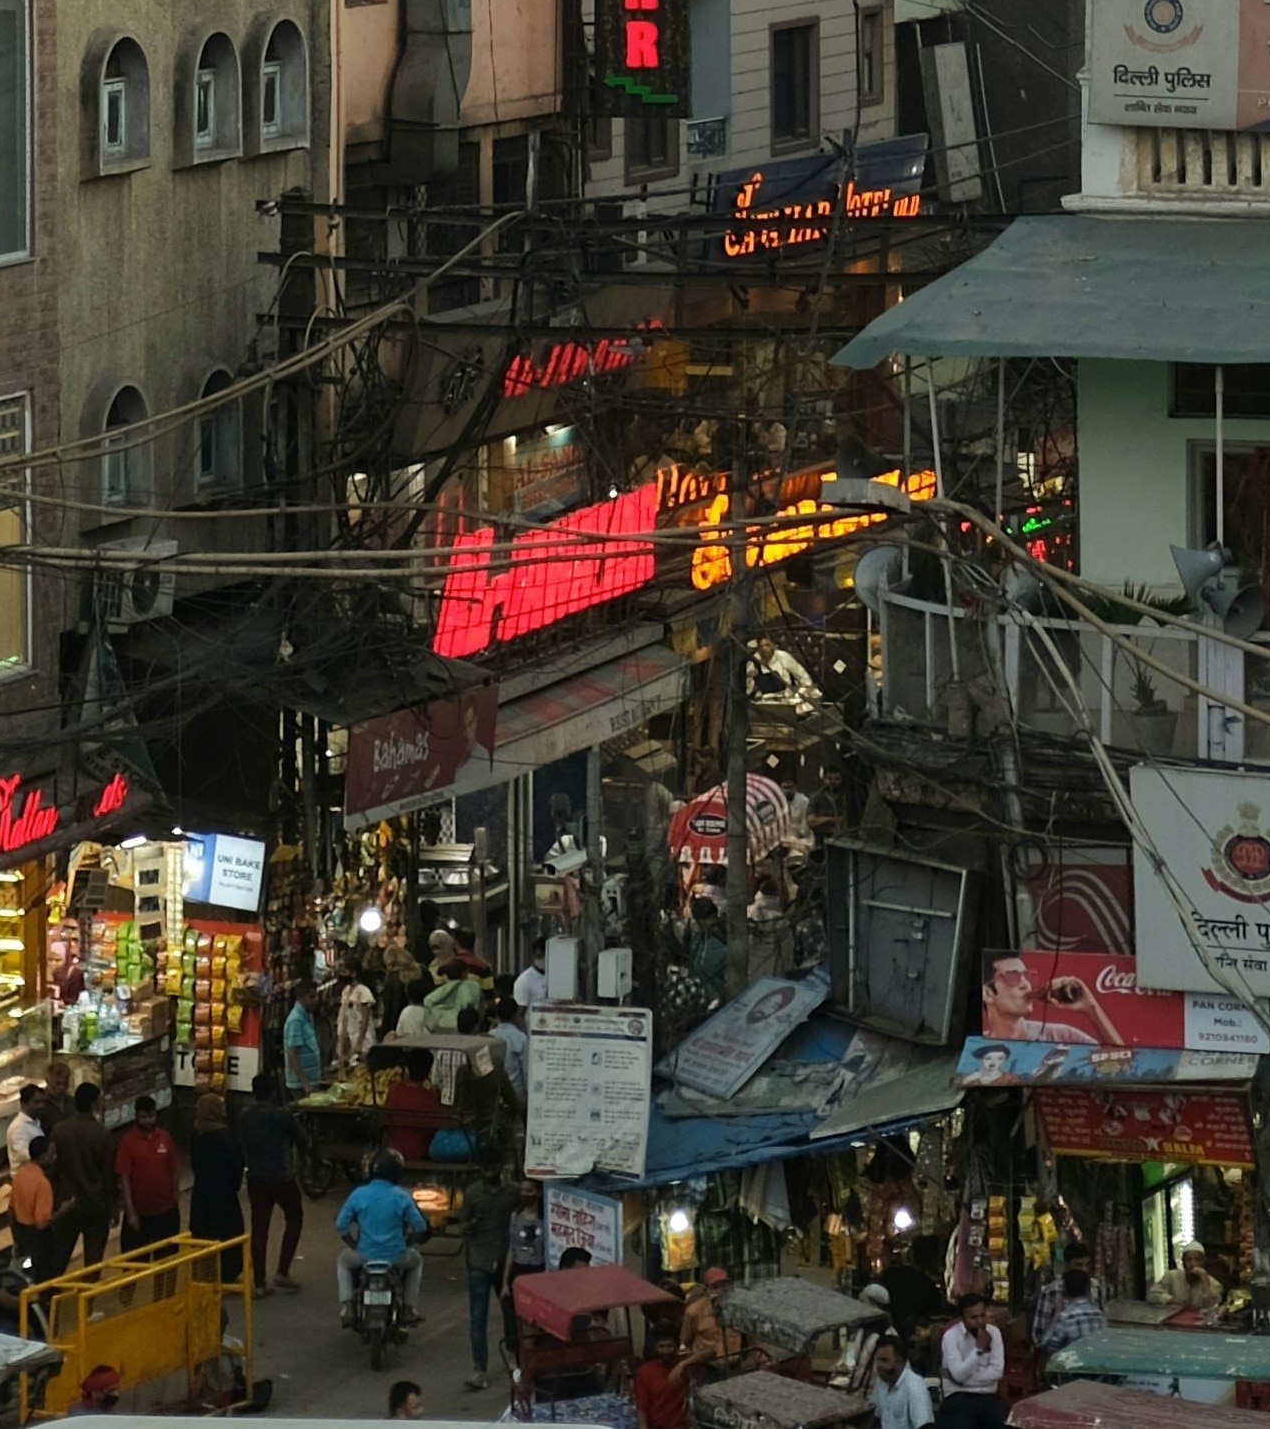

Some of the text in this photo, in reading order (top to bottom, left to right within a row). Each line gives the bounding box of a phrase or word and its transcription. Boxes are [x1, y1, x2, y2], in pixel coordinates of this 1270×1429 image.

[1113, 64, 1211, 93] दिल्ली पुलिस
[373, 730, 429, 773] Bahamas
[217, 854, 261, 870] UNI BAKE
[221, 868, 253, 882] STORE
[1192, 1000, 1250, 1012] PAN CORN
[1189, 1056, 1256, 1066] CORNER
